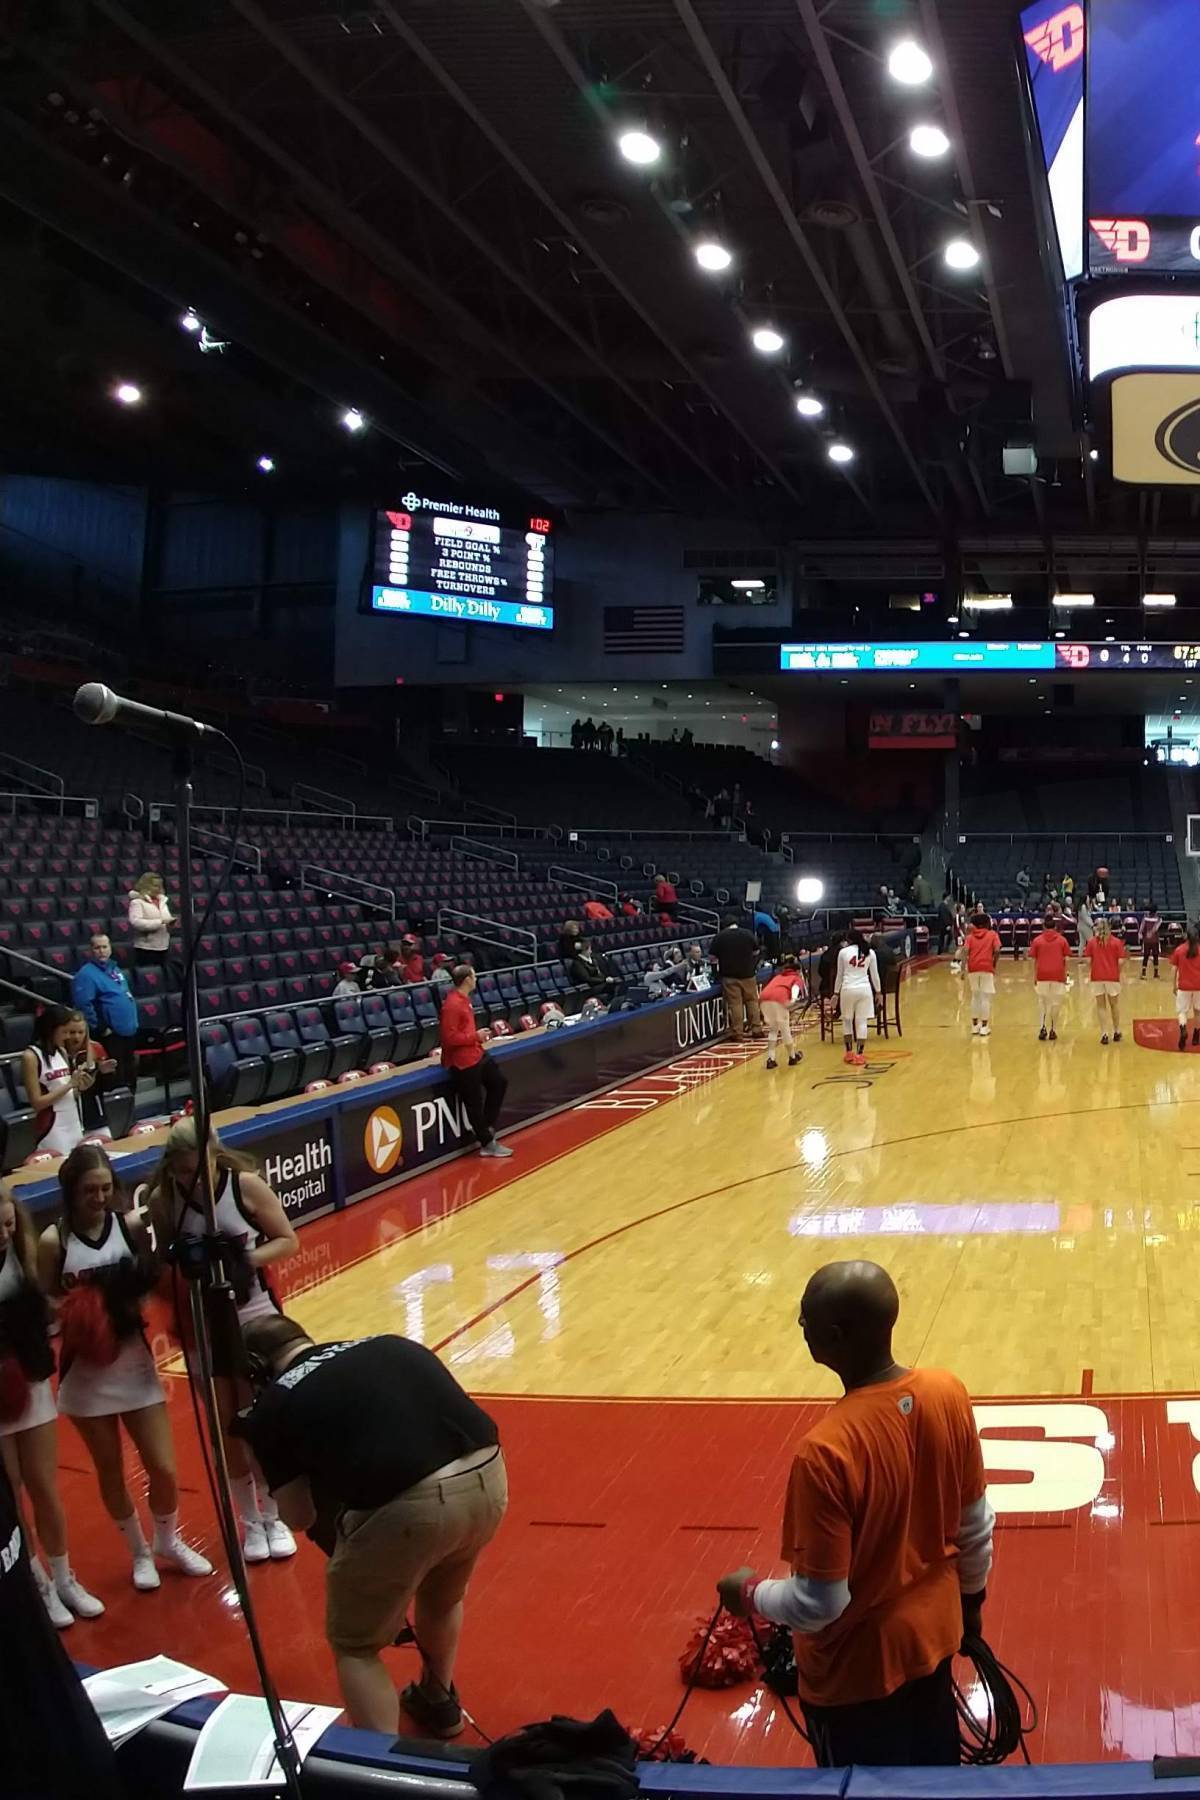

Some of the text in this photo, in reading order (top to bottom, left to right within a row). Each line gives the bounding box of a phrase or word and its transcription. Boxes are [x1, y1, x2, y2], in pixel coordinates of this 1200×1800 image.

[422, 498, 500, 520] Premier Health
[434, 536, 463, 548] FIELD
[465, 541, 491, 553] GOAL
[442, 548, 448, 556] 3
[451, 549, 481, 561] POINT
[439, 559, 491, 573] REBOUNDS
[430, 568, 456, 579] FREE
[458, 571, 499, 586] THROWS
[436, 580, 495, 595] TURNOVERS
[430, 594, 464, 617] Dilly
[467, 600, 500, 622] Dilly
[1123, 653, 1130, 664] 4
[849, 956, 865, 968] 42
[265, 1137, 332, 1184] Health
